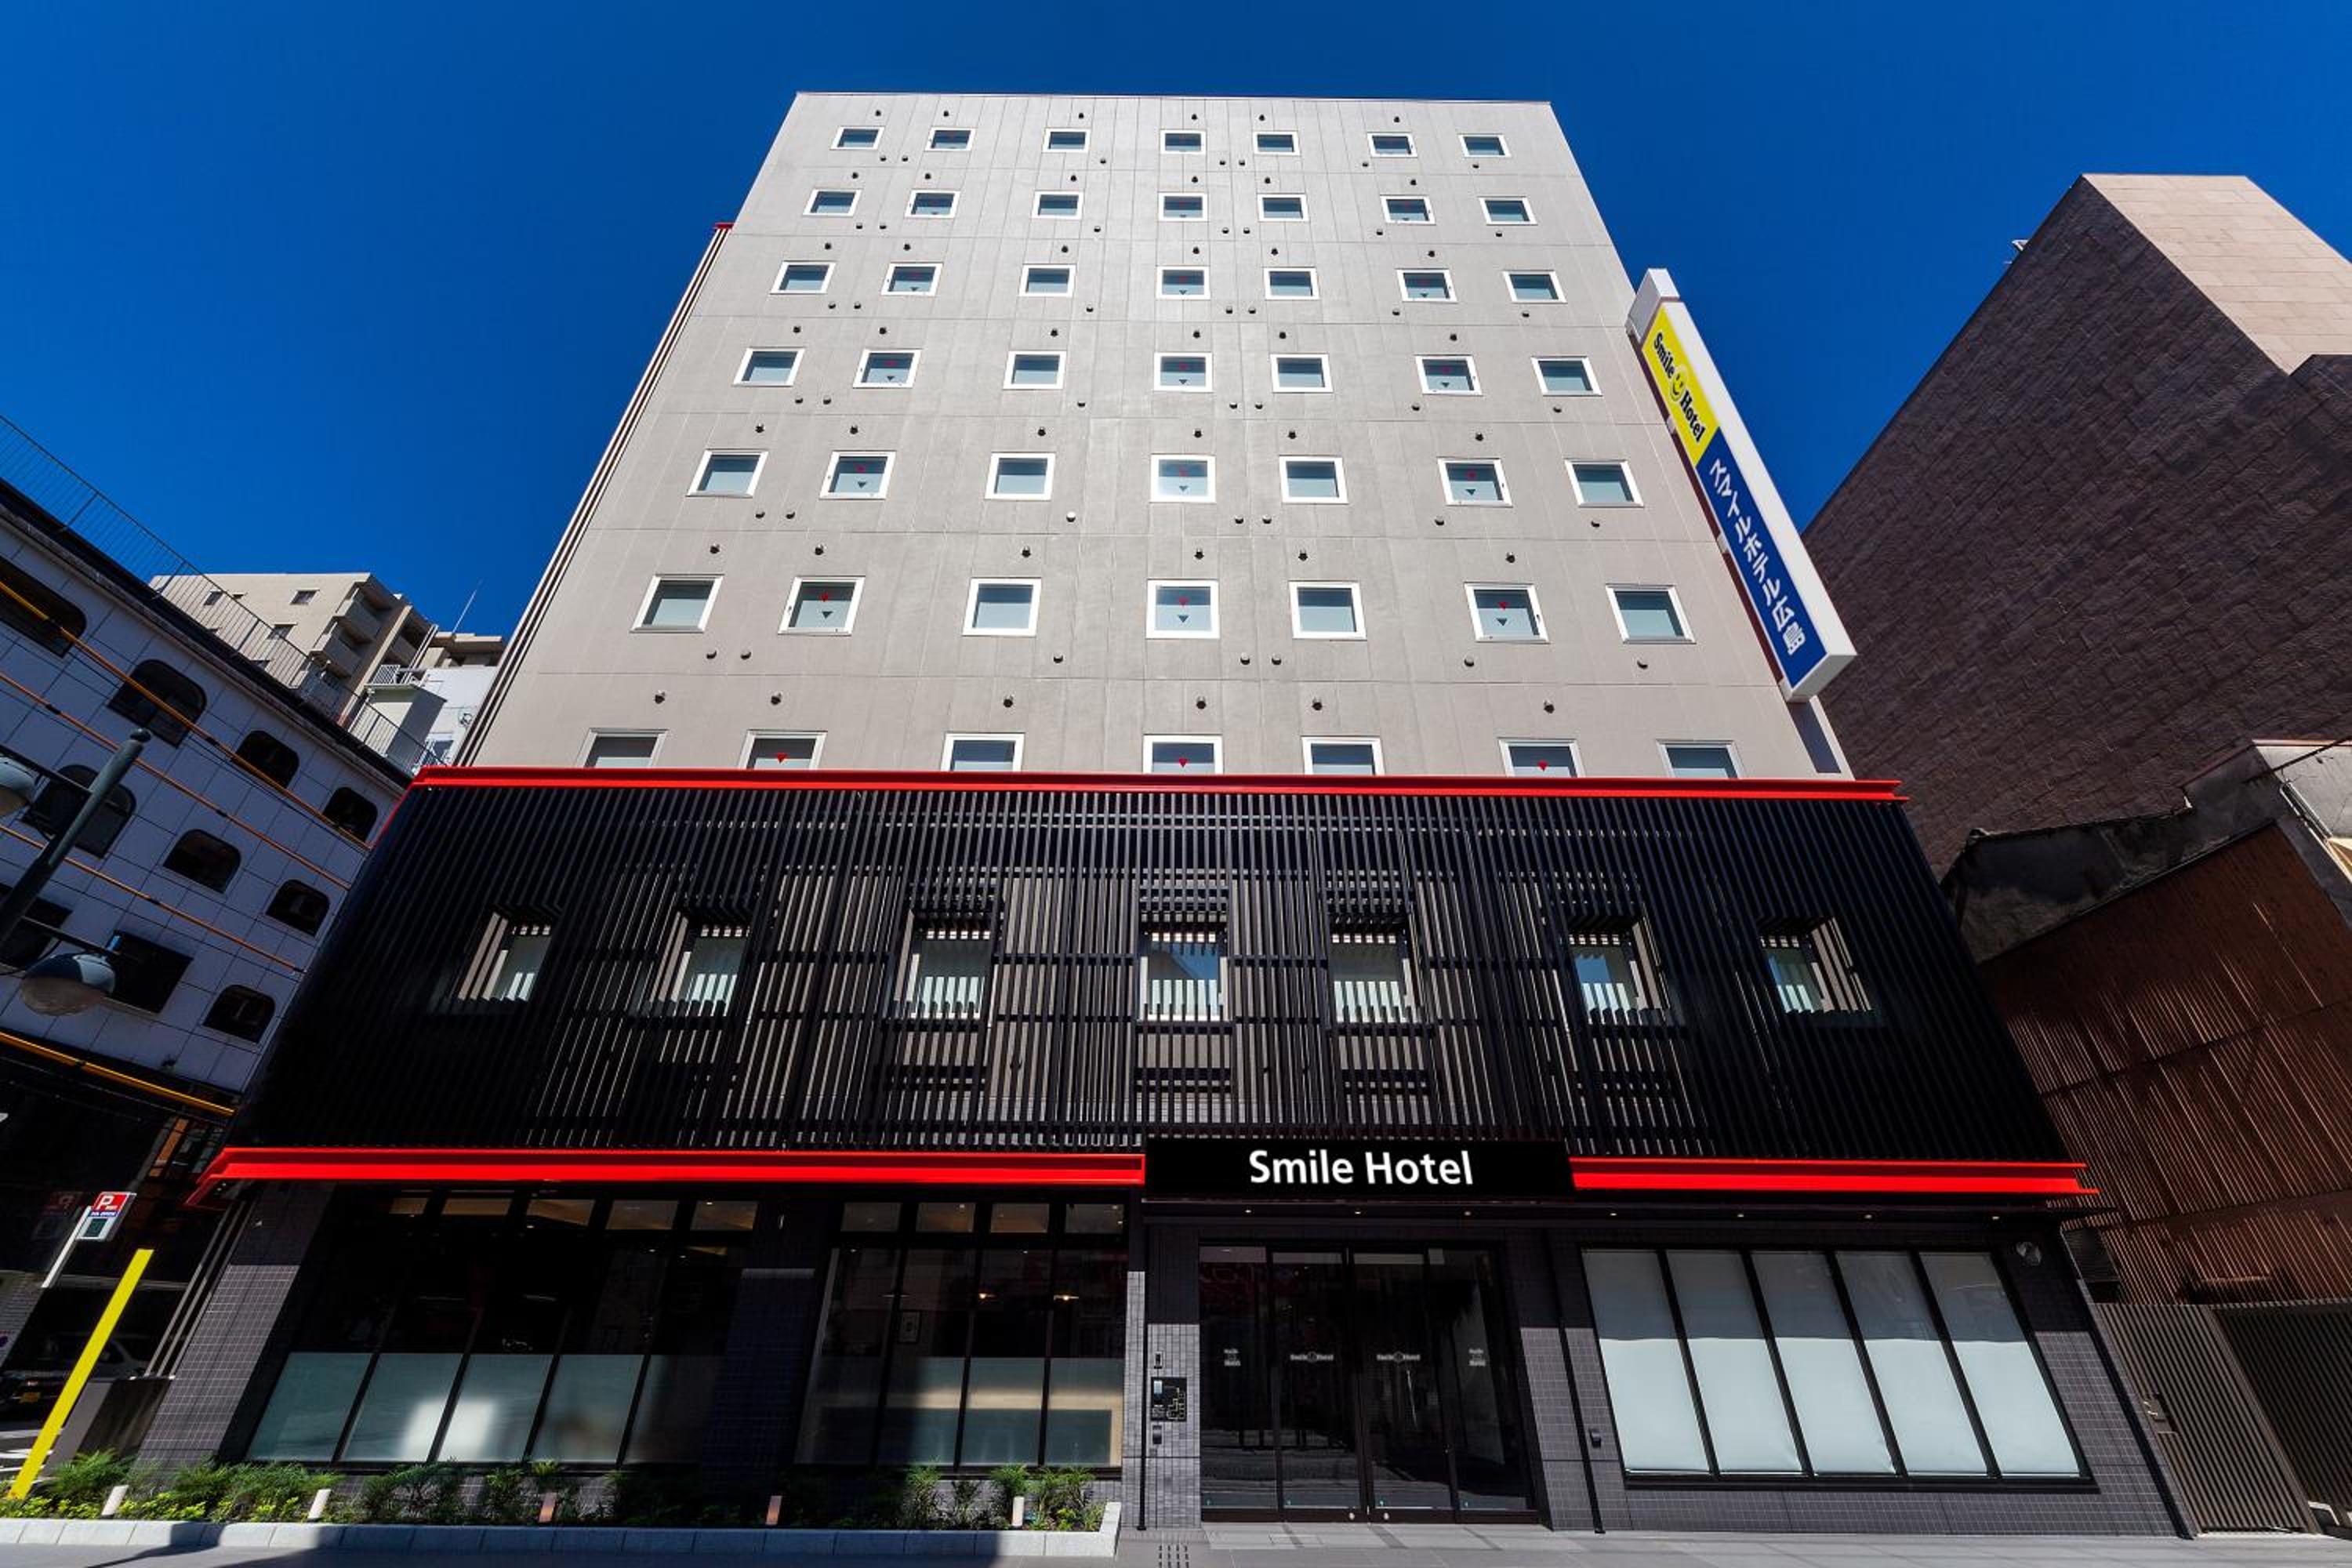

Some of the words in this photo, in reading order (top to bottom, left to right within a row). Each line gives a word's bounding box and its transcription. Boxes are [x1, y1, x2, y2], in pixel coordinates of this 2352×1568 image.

[1654, 332, 1675, 378] Smile
[1680, 390, 1705, 442] Hotel
[1710, 459, 1806, 655] スマイルホテル広島
[96, 1196, 114, 1210] P
[1249, 1149, 1354, 1184] Smile
[1365, 1150, 1473, 1185] Hotel
